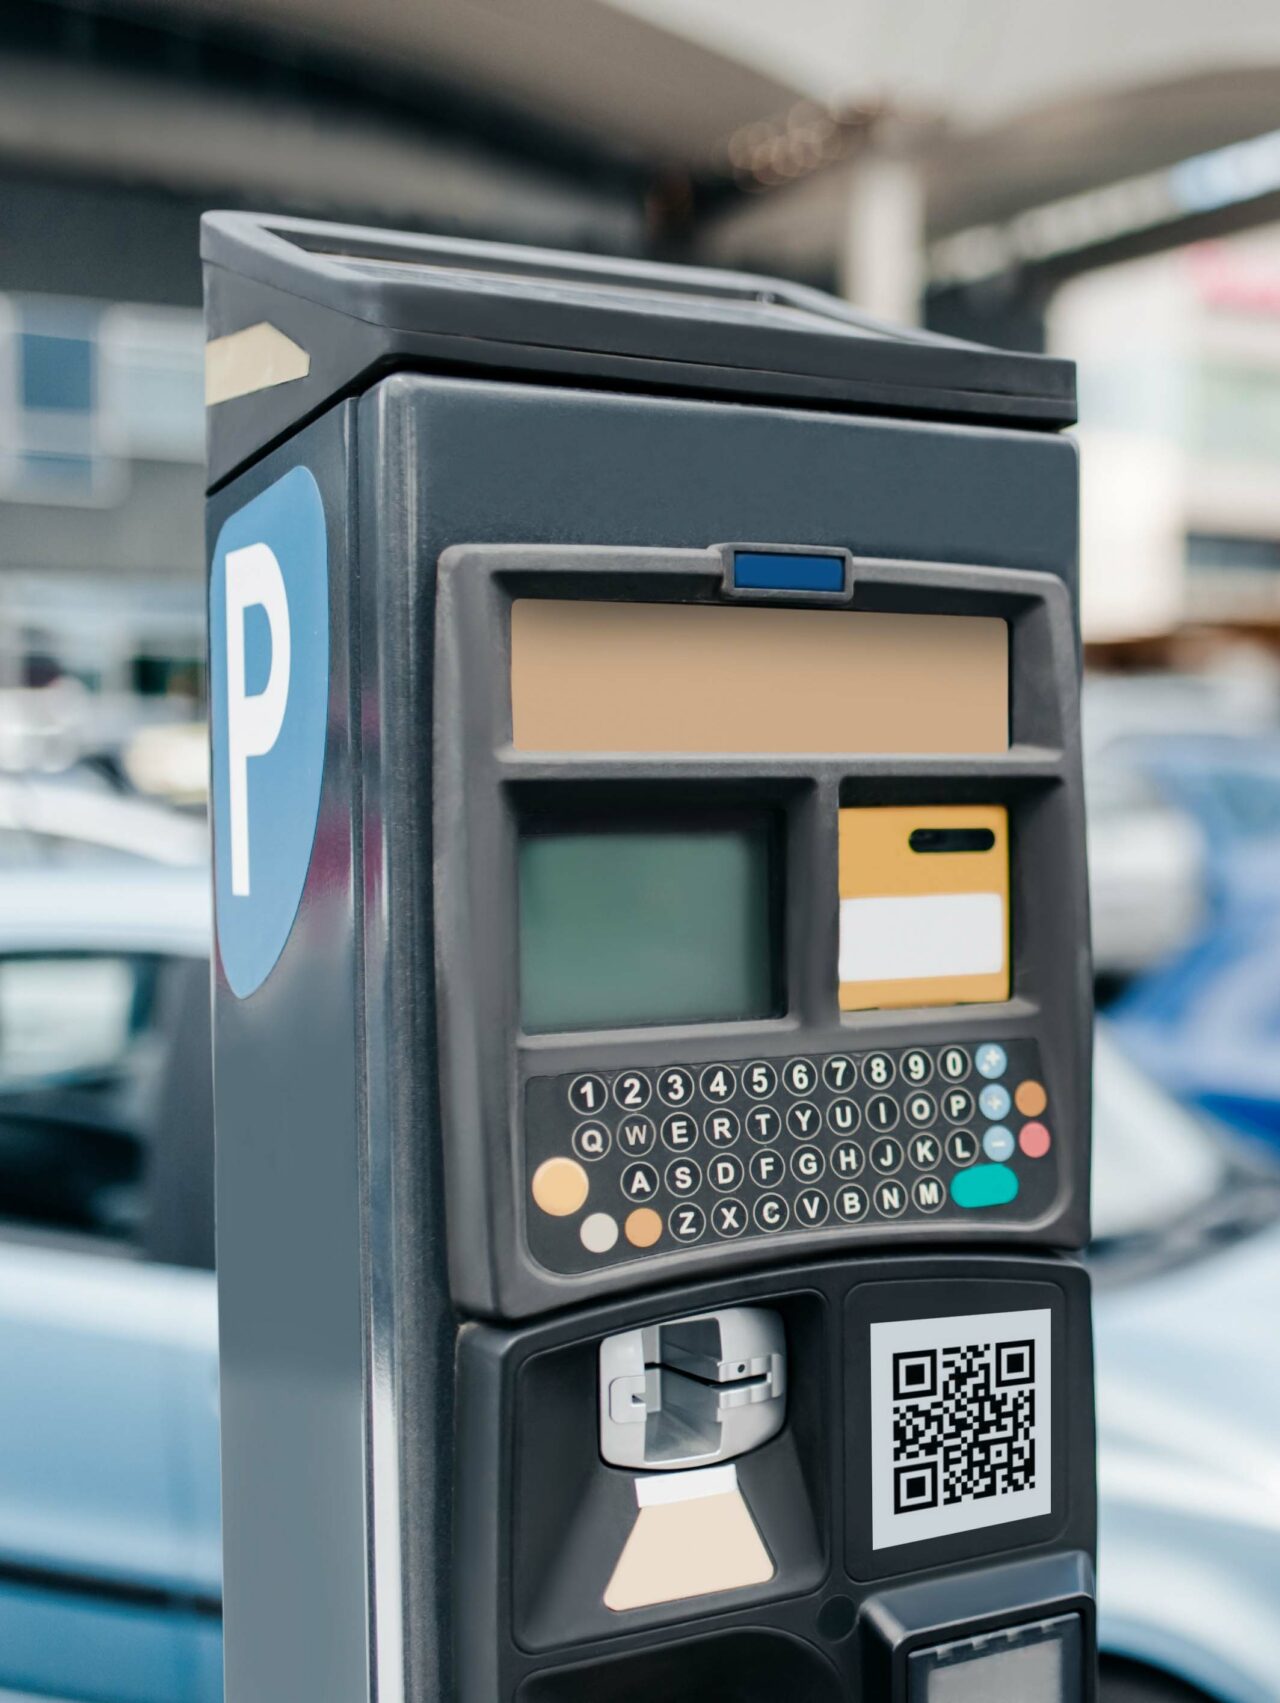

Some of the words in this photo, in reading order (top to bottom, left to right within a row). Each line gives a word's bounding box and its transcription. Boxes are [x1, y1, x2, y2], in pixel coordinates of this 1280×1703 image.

[225, 543, 291, 897] P
[580, 1081, 595, 1108] 1
[623, 1077, 642, 1105] 2
[667, 1074, 685, 1101] 3
[709, 1070, 728, 1097] 4
[752, 1067, 768, 1094] 5
[792, 1063, 809, 1090] 6
[831, 1060, 847, 1087] 7
[870, 1057, 887, 1084] 8
[908, 1054, 925, 1081] 9
[946, 1050, 963, 1077] 0
[581, 1129, 604, 1153] Q
[624, 1124, 647, 1146] W
[671, 1120, 689, 1144] E
[713, 1117, 733, 1140] R
[754, 1113, 771, 1136] T
[794, 1109, 812, 1132] Y
[835, 1105, 852, 1128] U
[911, 1098, 931, 1121] O
[950, 1094, 967, 1117] P
[630, 1170, 651, 1194] A
[674, 1166, 693, 1189] S
[716, 1162, 735, 1185] D
[760, 1157, 775, 1180] F
[798, 1152, 818, 1176] G
[839, 1148, 858, 1171] H
[879, 1144, 893, 1167] J
[916, 1139, 935, 1163] K
[954, 1137, 971, 1159] L
[678, 1211, 697, 1235] Z
[720, 1206, 740, 1230] X
[762, 1201, 781, 1224] C
[802, 1196, 820, 1219] V
[843, 1192, 861, 1215] B
[882, 1187, 900, 1210] N
[918, 1182, 939, 1206] M
